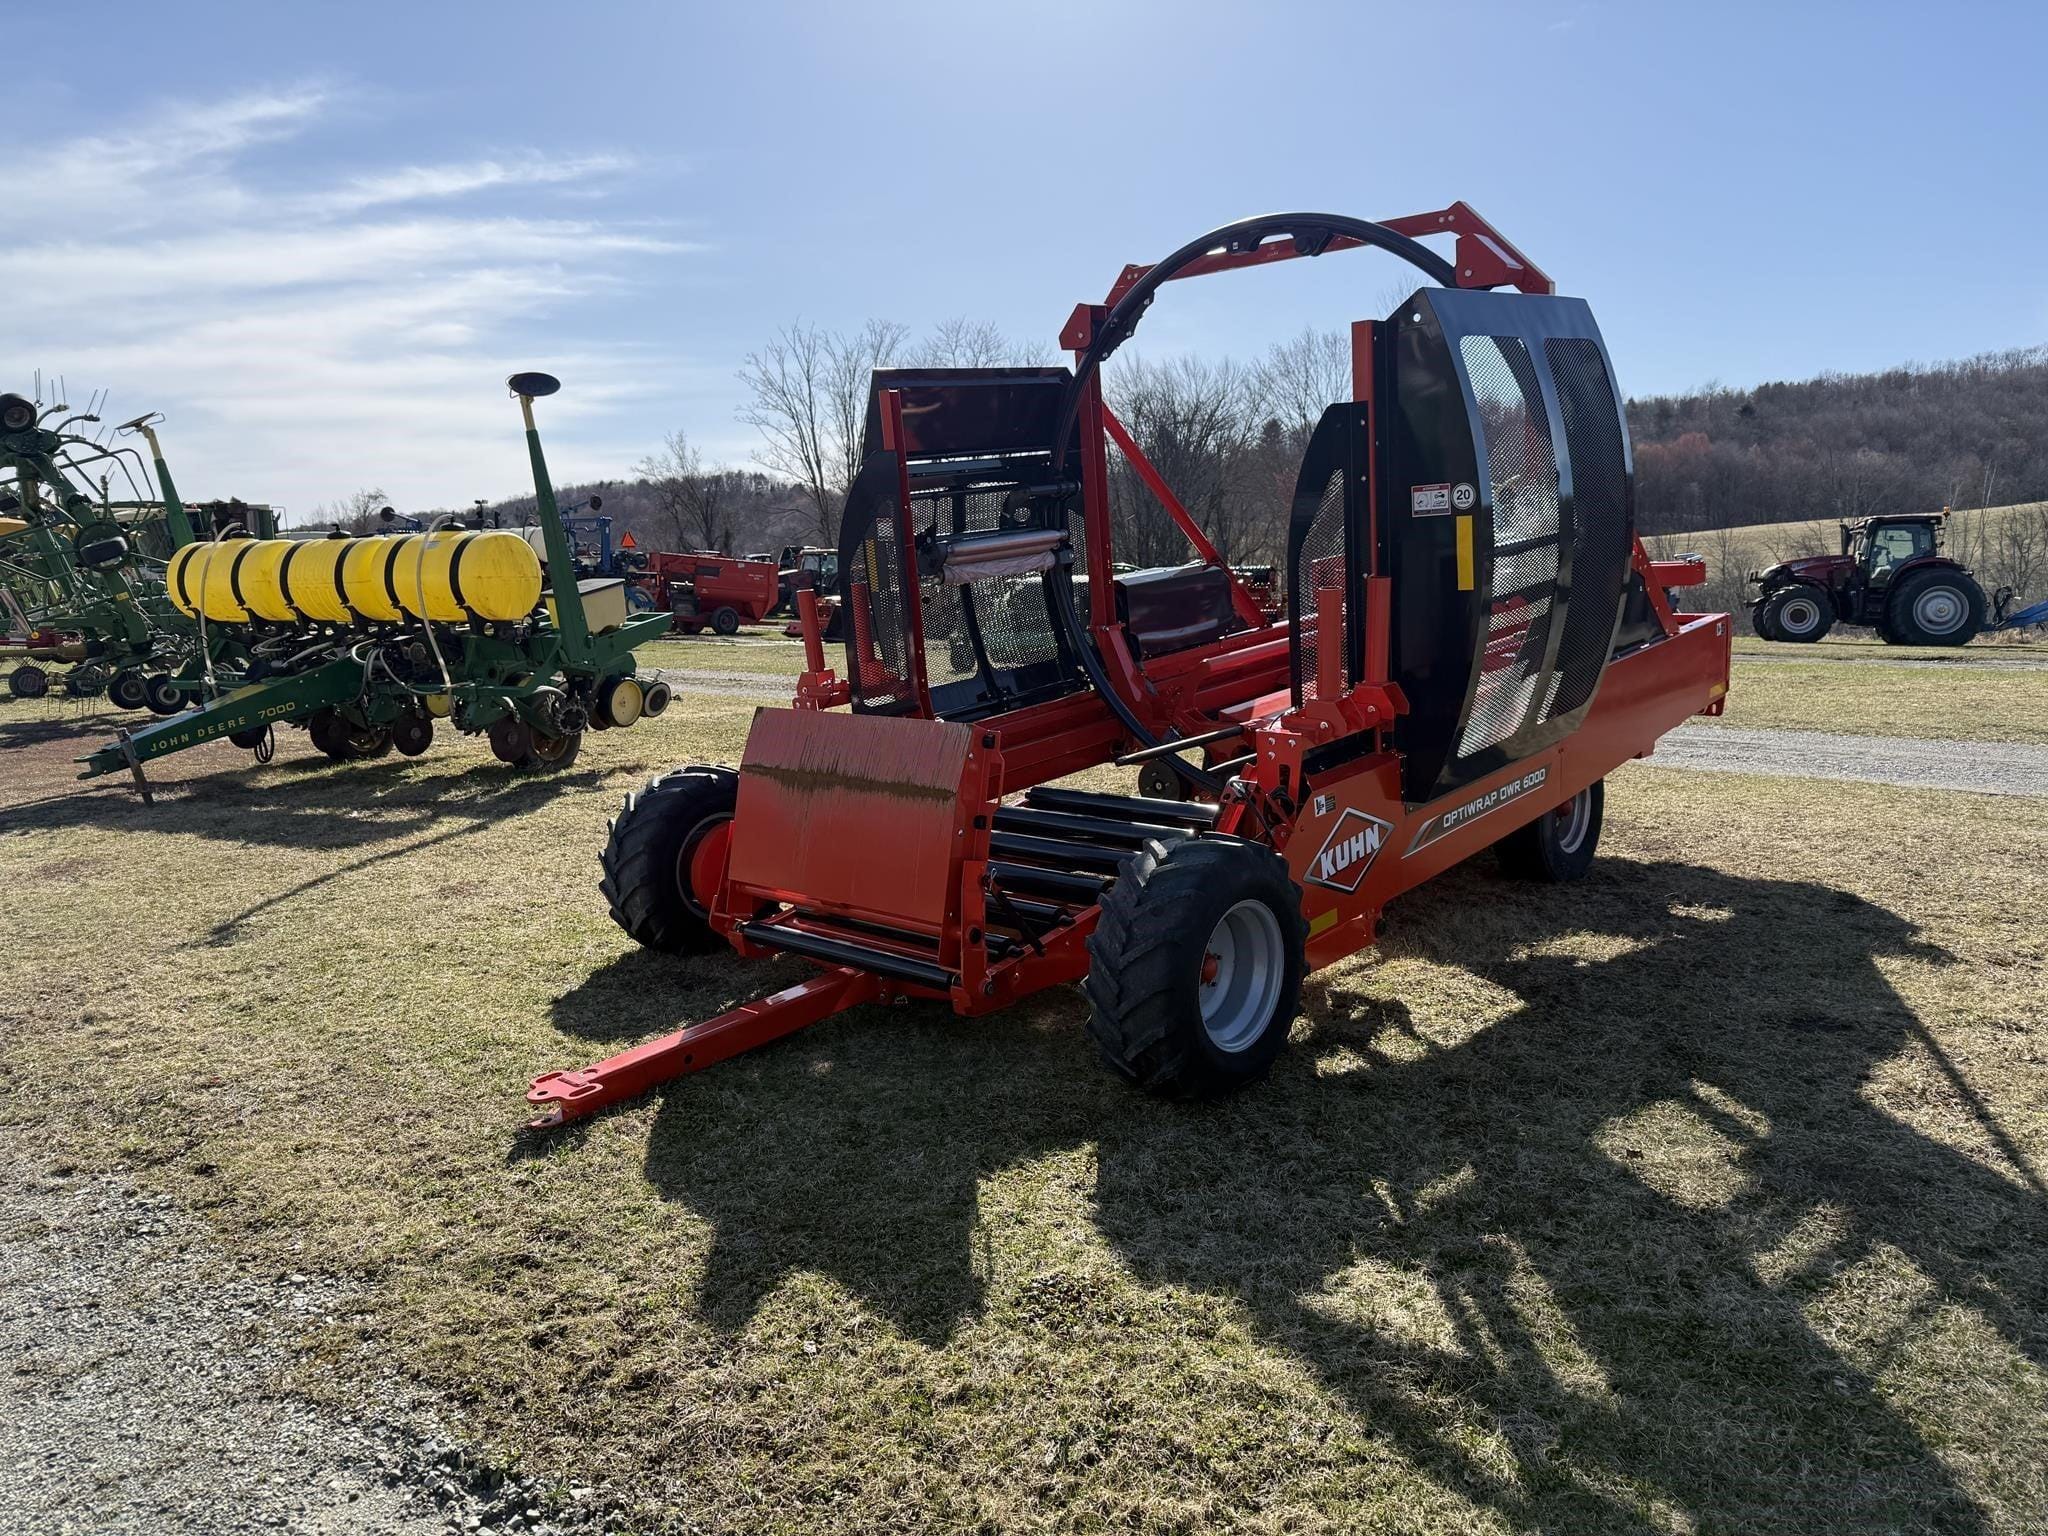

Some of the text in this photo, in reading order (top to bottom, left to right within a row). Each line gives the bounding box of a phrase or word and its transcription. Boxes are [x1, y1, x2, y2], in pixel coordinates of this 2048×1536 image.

[1456, 489, 1470, 500] 20
[150, 702, 296, 752] JOHN DEERE 7000
[1443, 791, 1497, 828] OPTIWRAP
[1523, 768, 1546, 789] 6000
[1320, 823, 1380, 881] KUHN
